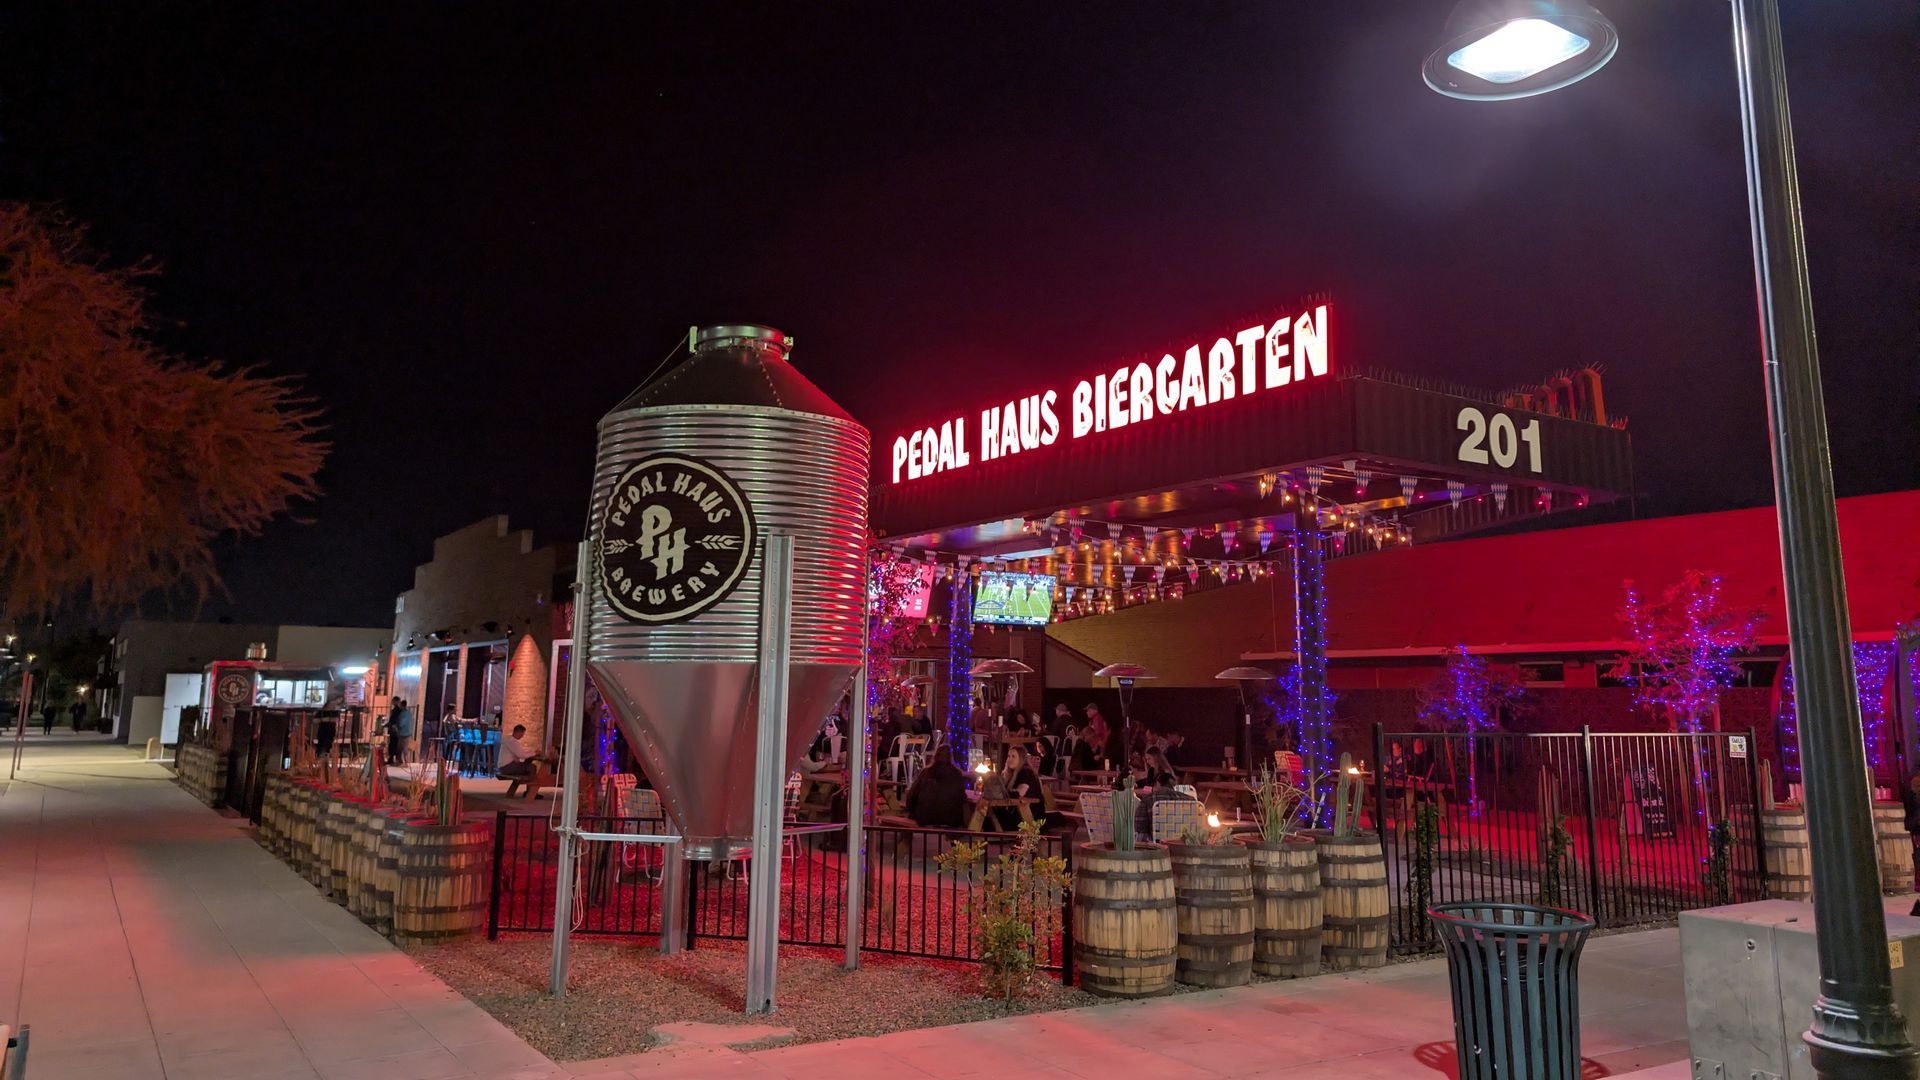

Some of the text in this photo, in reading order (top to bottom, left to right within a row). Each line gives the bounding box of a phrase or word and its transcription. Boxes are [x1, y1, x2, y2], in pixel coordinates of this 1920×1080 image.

[892, 304, 1329, 484] PEDAL HAUS BIERGARTEN
[1457, 407, 1542, 473] 201
[611, 471, 732, 528] PEDAL HAUS
[635, 504, 691, 581] PH
[611, 560, 721, 606] BREWERY
